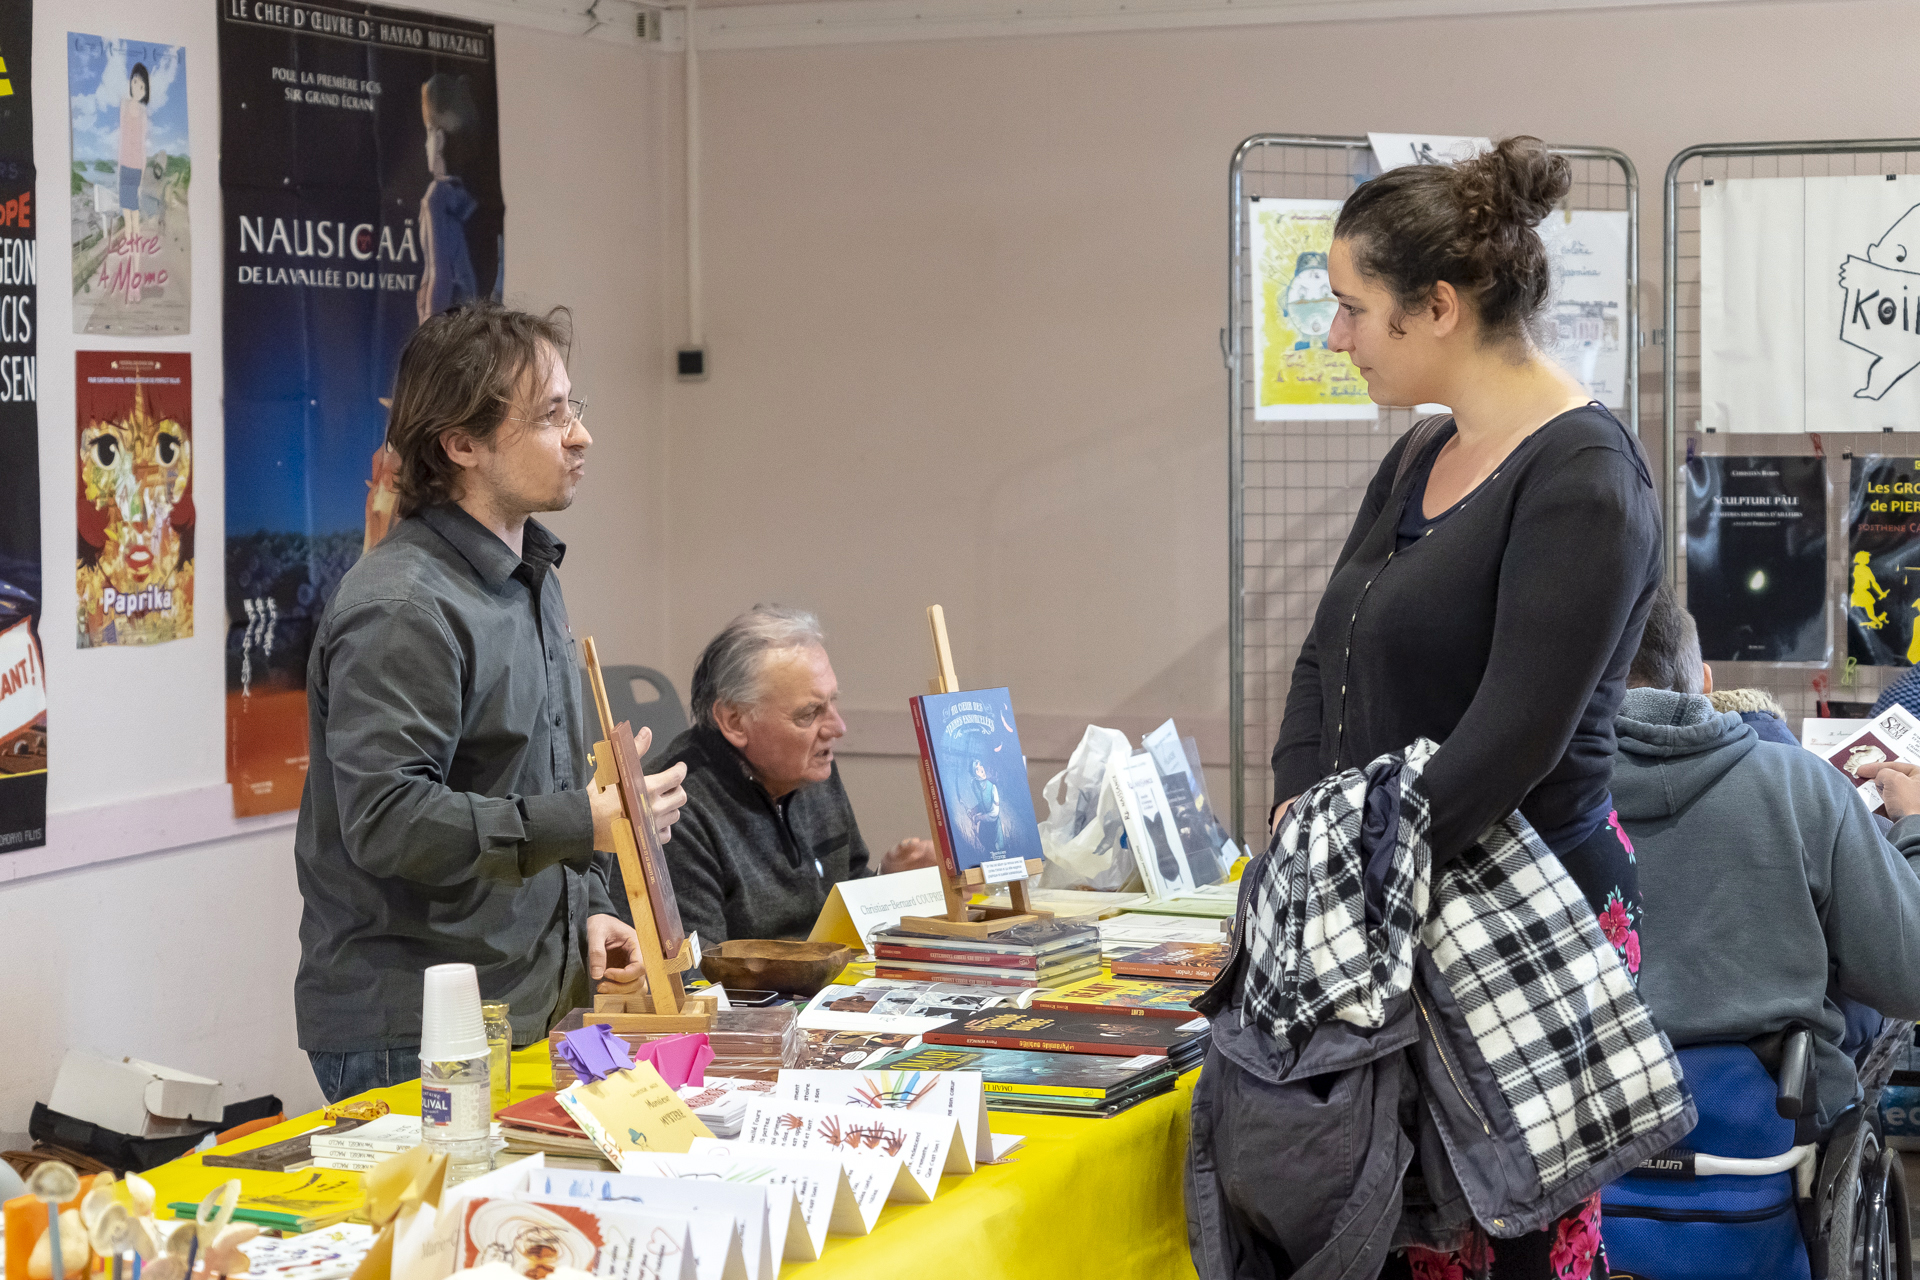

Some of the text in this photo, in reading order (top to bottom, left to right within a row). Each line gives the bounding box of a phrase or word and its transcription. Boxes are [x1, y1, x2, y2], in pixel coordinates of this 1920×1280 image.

[232, 0, 248, 18] LE
[254, 2, 290, 26] CHEF
[301, 71, 315, 84] LA
[305, 90, 339, 106] GRAND
[108, 226, 161, 255] Lettre
[111, 256, 168, 304] Momo
[238, 266, 417, 291] DE LA VALLÉE DU VENT
[1851, 285, 1920, 335] Koi
[1868, 482, 1890, 493] Les
[1713, 495, 1772, 505] SCULPTURE
[1870, 499, 1888, 512] de
[103, 585, 173, 615] Paprika
[1041, 1042, 1069, 1051] Pyramide
[993, 1084, 1013, 1092] OMAR
[1636, 1159, 1683, 1170] ELIUM
